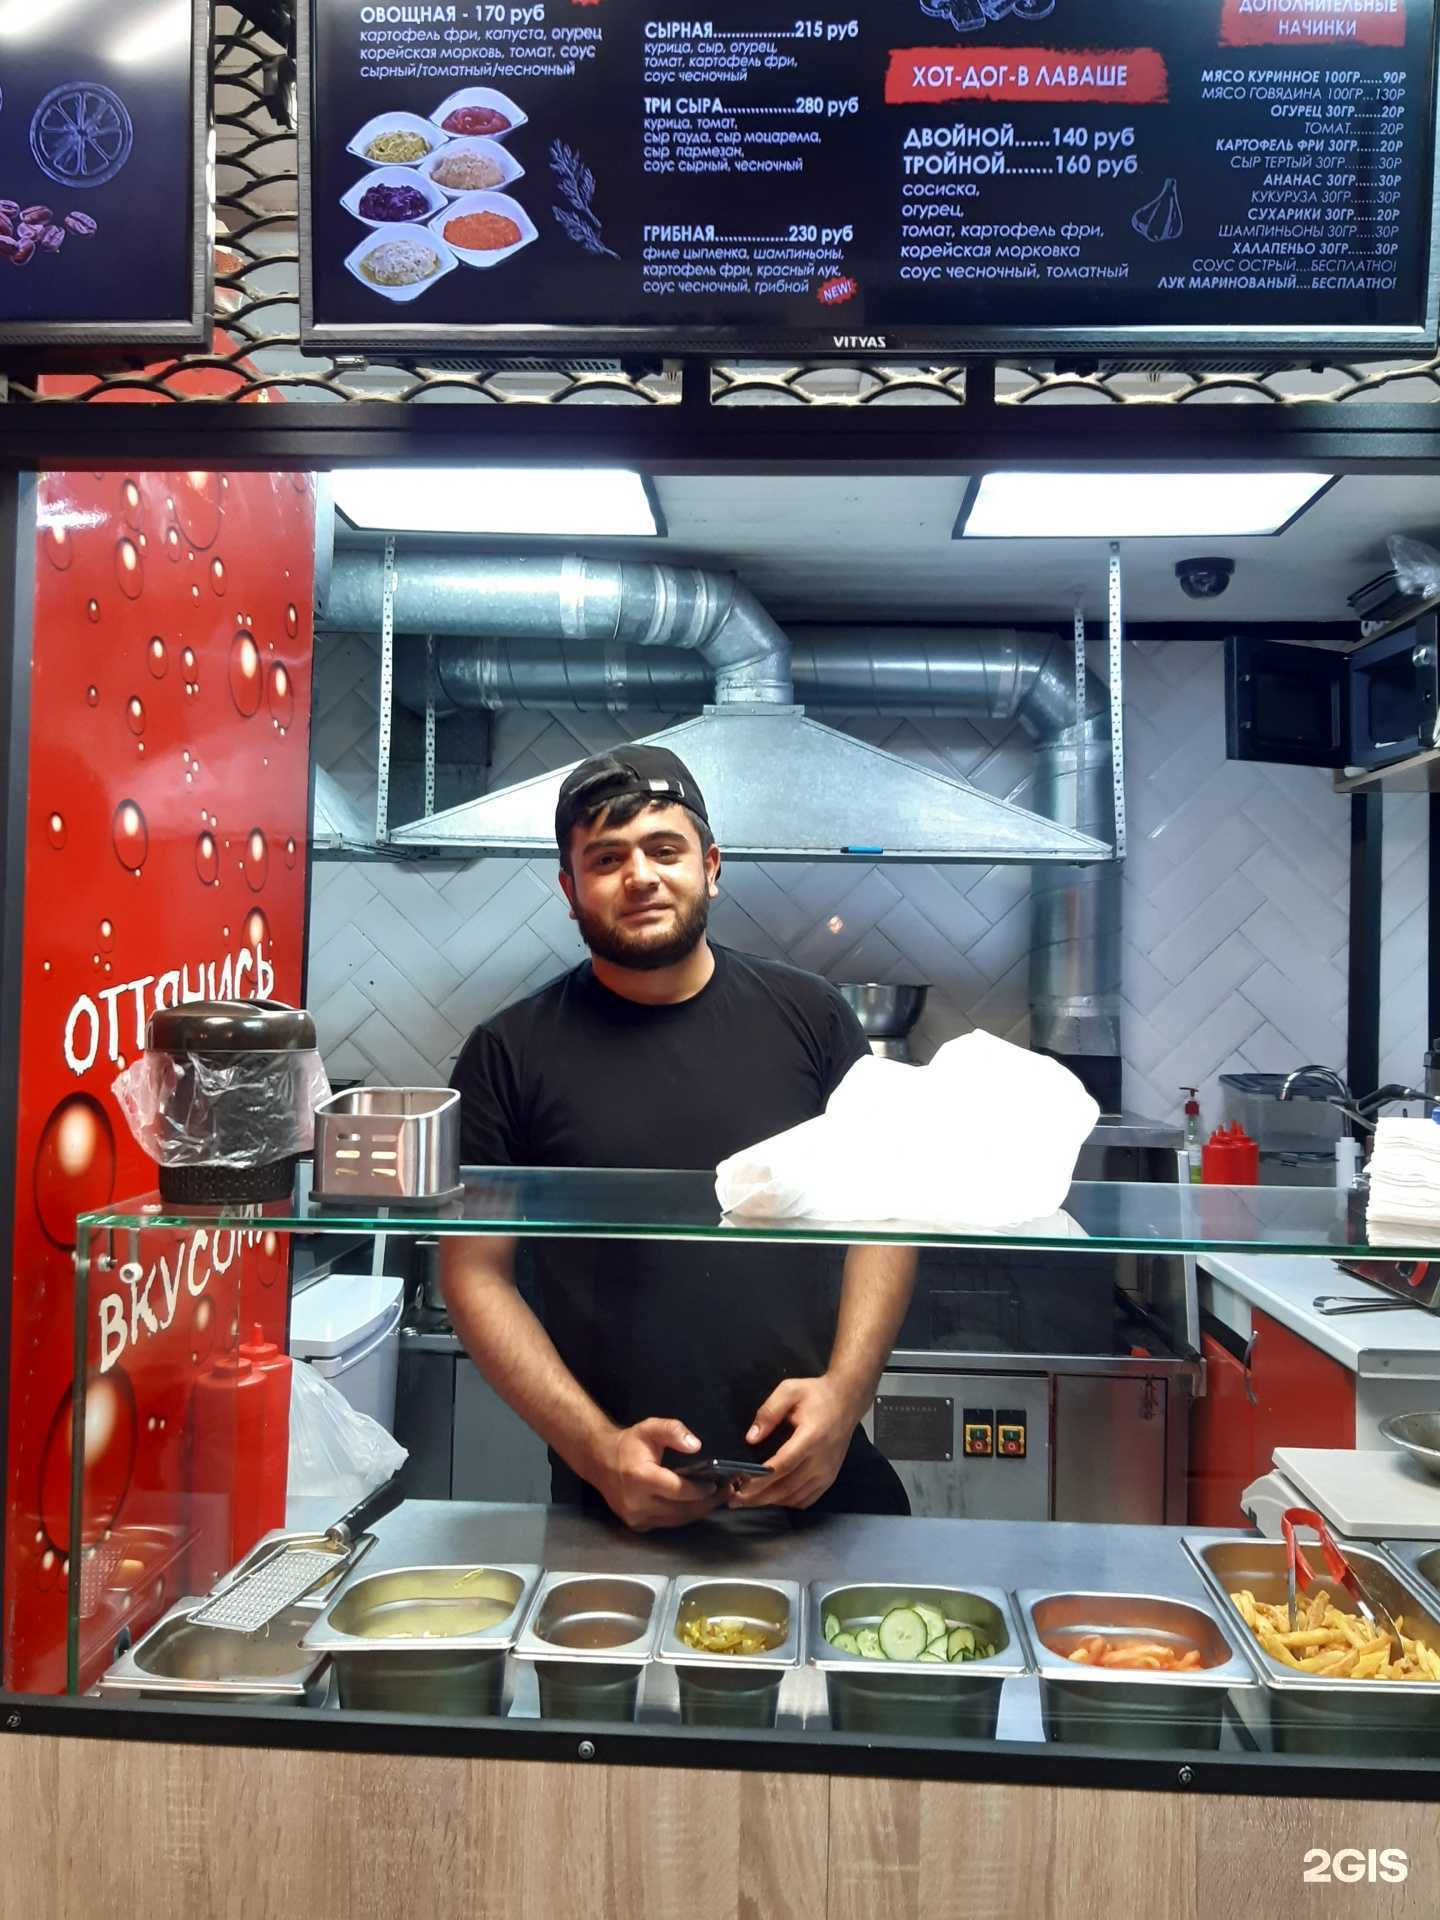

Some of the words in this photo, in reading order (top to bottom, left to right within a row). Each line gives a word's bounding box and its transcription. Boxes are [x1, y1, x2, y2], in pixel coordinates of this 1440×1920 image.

[1239, 0, 1397, 13] ДОПОЛНИТЕЛЬНЫЕ
[361, 7, 455, 24] ОВОЩНАЯ
[475, 6, 504, 21] 170
[511, 4, 545, 25] руб
[645, 22, 712, 38] СЫРНАЯ
[795, 21, 822, 37] 215
[828, 20, 858, 40] руб
[1279, 20, 1356, 36] НАЧИНКИ
[361, 27, 440, 44] картофель
[444, 27, 480, 43] фри,
[485, 30, 546, 43] капуста,
[552, 27, 602, 42] огурец
[361, 46, 436, 61] корейская
[440, 47, 504, 61] морковь,
[510, 46, 555, 59] томат,
[560, 45, 596, 59] соус
[361, 61, 575, 80] сырный/томатный/чесночный
[644, 71, 675, 82] соус
[679, 69, 747, 82] чесночный
[913, 66, 1029, 89] ХОТ-ДОГ-В
[1036, 65, 1127, 86] ЛАВАШЕ
[1201, 70, 1244, 82] МЯСО
[1248, 70, 1320, 82] КУРИННОЕ
[1325, 71, 1359, 83] 100ГР
[1383, 72, 1405, 84] 90Р
[1201, 88, 1245, 100] МЯСО
[1249, 88, 1321, 101] ГОВЯДИНА
[1328, 88, 1362, 100] 100ГР
[1375, 89, 1405, 100] 130Р
[644, 98, 670, 113] ТРИ
[676, 98, 723, 113] СЫРА
[796, 98, 822, 112] 280
[828, 96, 858, 116] руб
[1271, 105, 1322, 119] ОГУРЕЦ
[1326, 105, 1355, 117] 30ГР
[1381, 106, 1404, 118] 20Р
[1305, 122, 1351, 134] ТОМАТ
[1380, 123, 1404, 135] 20Р
[903, 124, 1014, 148] ДВОЙНОЙ
[1052, 127, 1087, 146] 140
[1094, 127, 1134, 150] руб
[1216, 139, 1293, 151] КАРТОФЕЛЬ
[1297, 139, 1325, 151] ФРИ
[1328, 139, 1357, 152] 30ГР
[1380, 140, 1403, 152] 20Р
[903, 151, 1004, 175] ТРОЙНОЙ
[1055, 155, 1090, 174] 160
[1097, 155, 1137, 178] руб
[1230, 157, 1261, 169] СЫР
[1264, 155, 1312, 168] ТЕРТЫЙ
[1316, 157, 1345, 169] 30ГР
[1378, 157, 1402, 169] 30Р
[1264, 174, 1322, 186] АНАНАС
[1326, 174, 1355, 186] 30ГР
[1378, 174, 1401, 186] 30Р
[902, 183, 980, 197] сосиска,
[1251, 191, 1317, 203] КУКУРУЗА
[1322, 191, 1351, 203] 30ГР
[1377, 191, 1400, 203] 30Р
[902, 203, 964, 217] огурец,
[1248, 208, 1321, 220] СУХАРИКИ
[1325, 208, 1354, 220] 30ГР
[1376, 209, 1400, 221] 20Р
[644, 226, 715, 242] ГРИБНАЯ
[789, 226, 816, 241] 230
[822, 225, 852, 245] руб
[901, 225, 955, 237] томат,
[960, 222, 1055, 240] картофель
[1060, 222, 1104, 239] фри,
[1218, 225, 1323, 237] ШАМПИНЬОНЫ
[1327, 225, 1357, 237] 30ГР
[1375, 225, 1399, 238] 30Р
[901, 242, 991, 260] корейская
[995, 245, 1080, 259] морковка
[1232, 243, 1316, 254] ХАЛАПЕНЬО
[1319, 243, 1348, 254] 30ГР
[1375, 243, 1398, 255] 30Р
[900, 266, 941, 280] соус
[946, 264, 1040, 279] чесночный,
[1046, 263, 1128, 278] томатный
